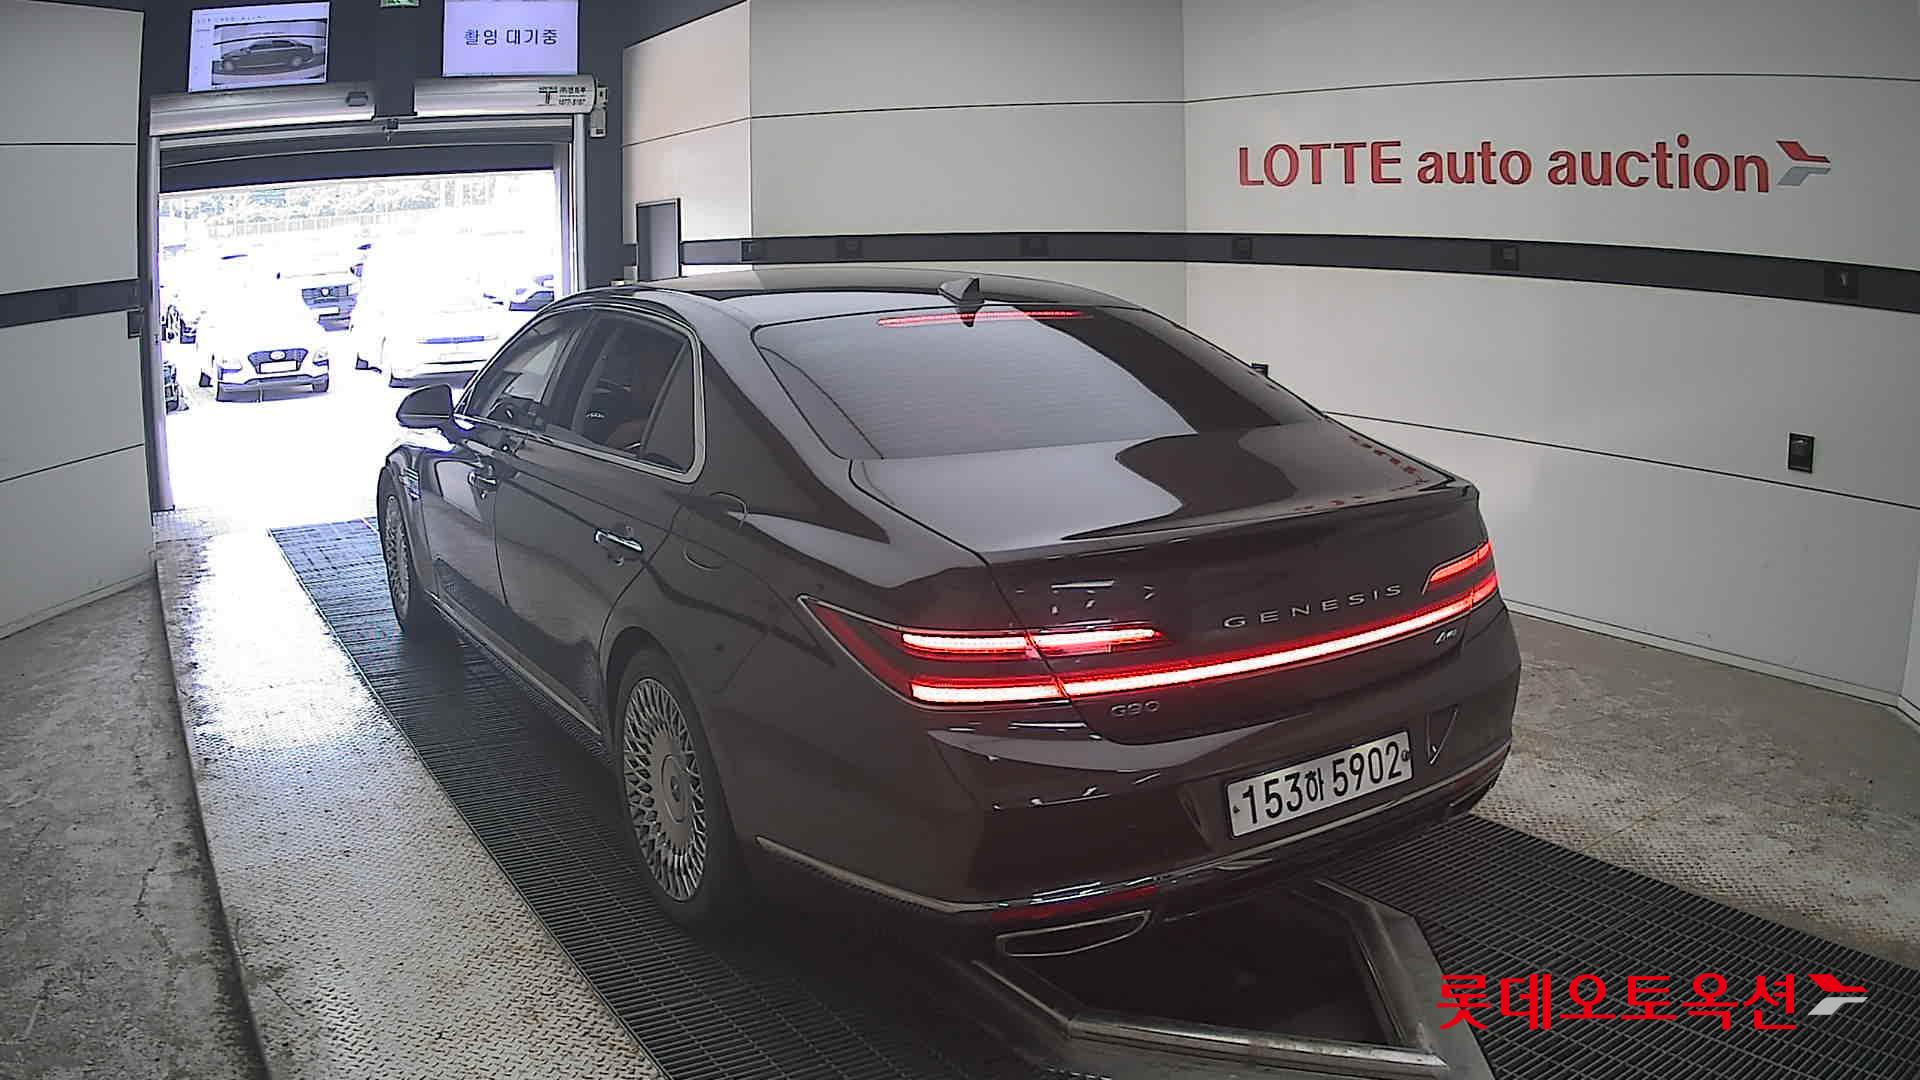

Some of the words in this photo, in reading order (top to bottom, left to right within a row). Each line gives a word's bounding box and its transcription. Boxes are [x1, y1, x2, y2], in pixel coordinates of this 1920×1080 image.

[1239, 140, 1401, 187] LOTTE
[1416, 141, 1531, 185] auto
[1547, 134, 1769, 193] auction
[1223, 585, 1401, 628] GENESIS
[1242, 767, 1325, 824] 153하
[1331, 741, 1402, 797] 5902
